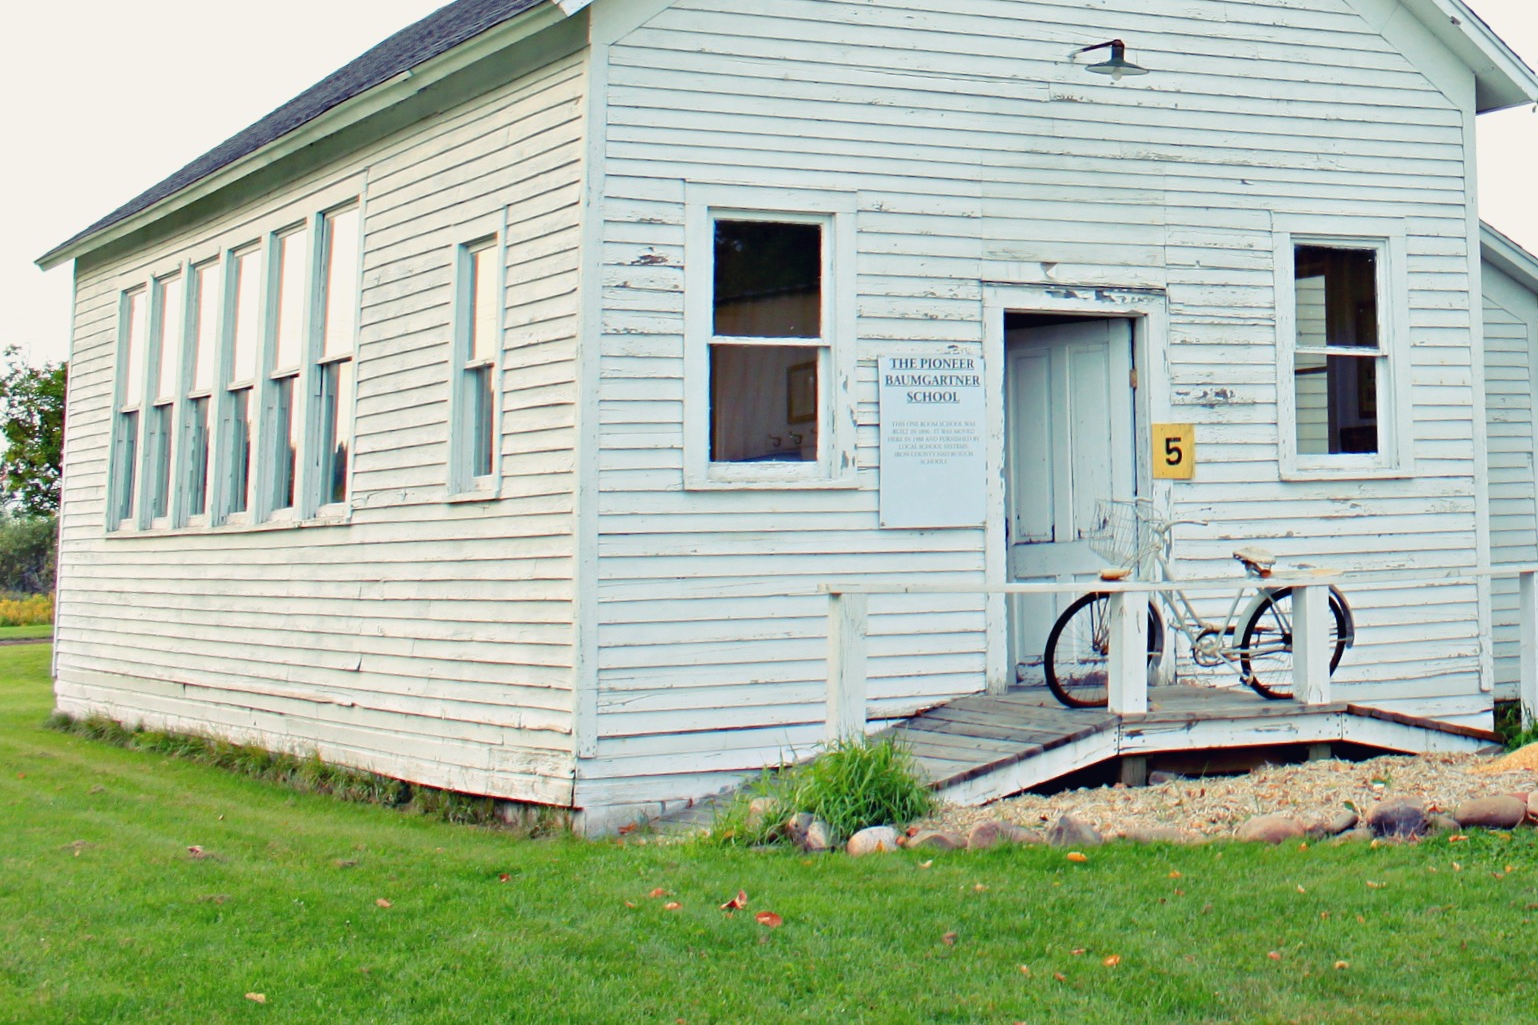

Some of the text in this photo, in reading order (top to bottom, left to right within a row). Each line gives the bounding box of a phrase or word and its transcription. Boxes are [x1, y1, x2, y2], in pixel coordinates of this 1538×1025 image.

[890, 358, 975, 369] THE PIONEER
[885, 375, 980, 386] BAUMGARTNER
[907, 391, 960, 403] SCHOOL
[1165, 437, 1183, 466] 5
